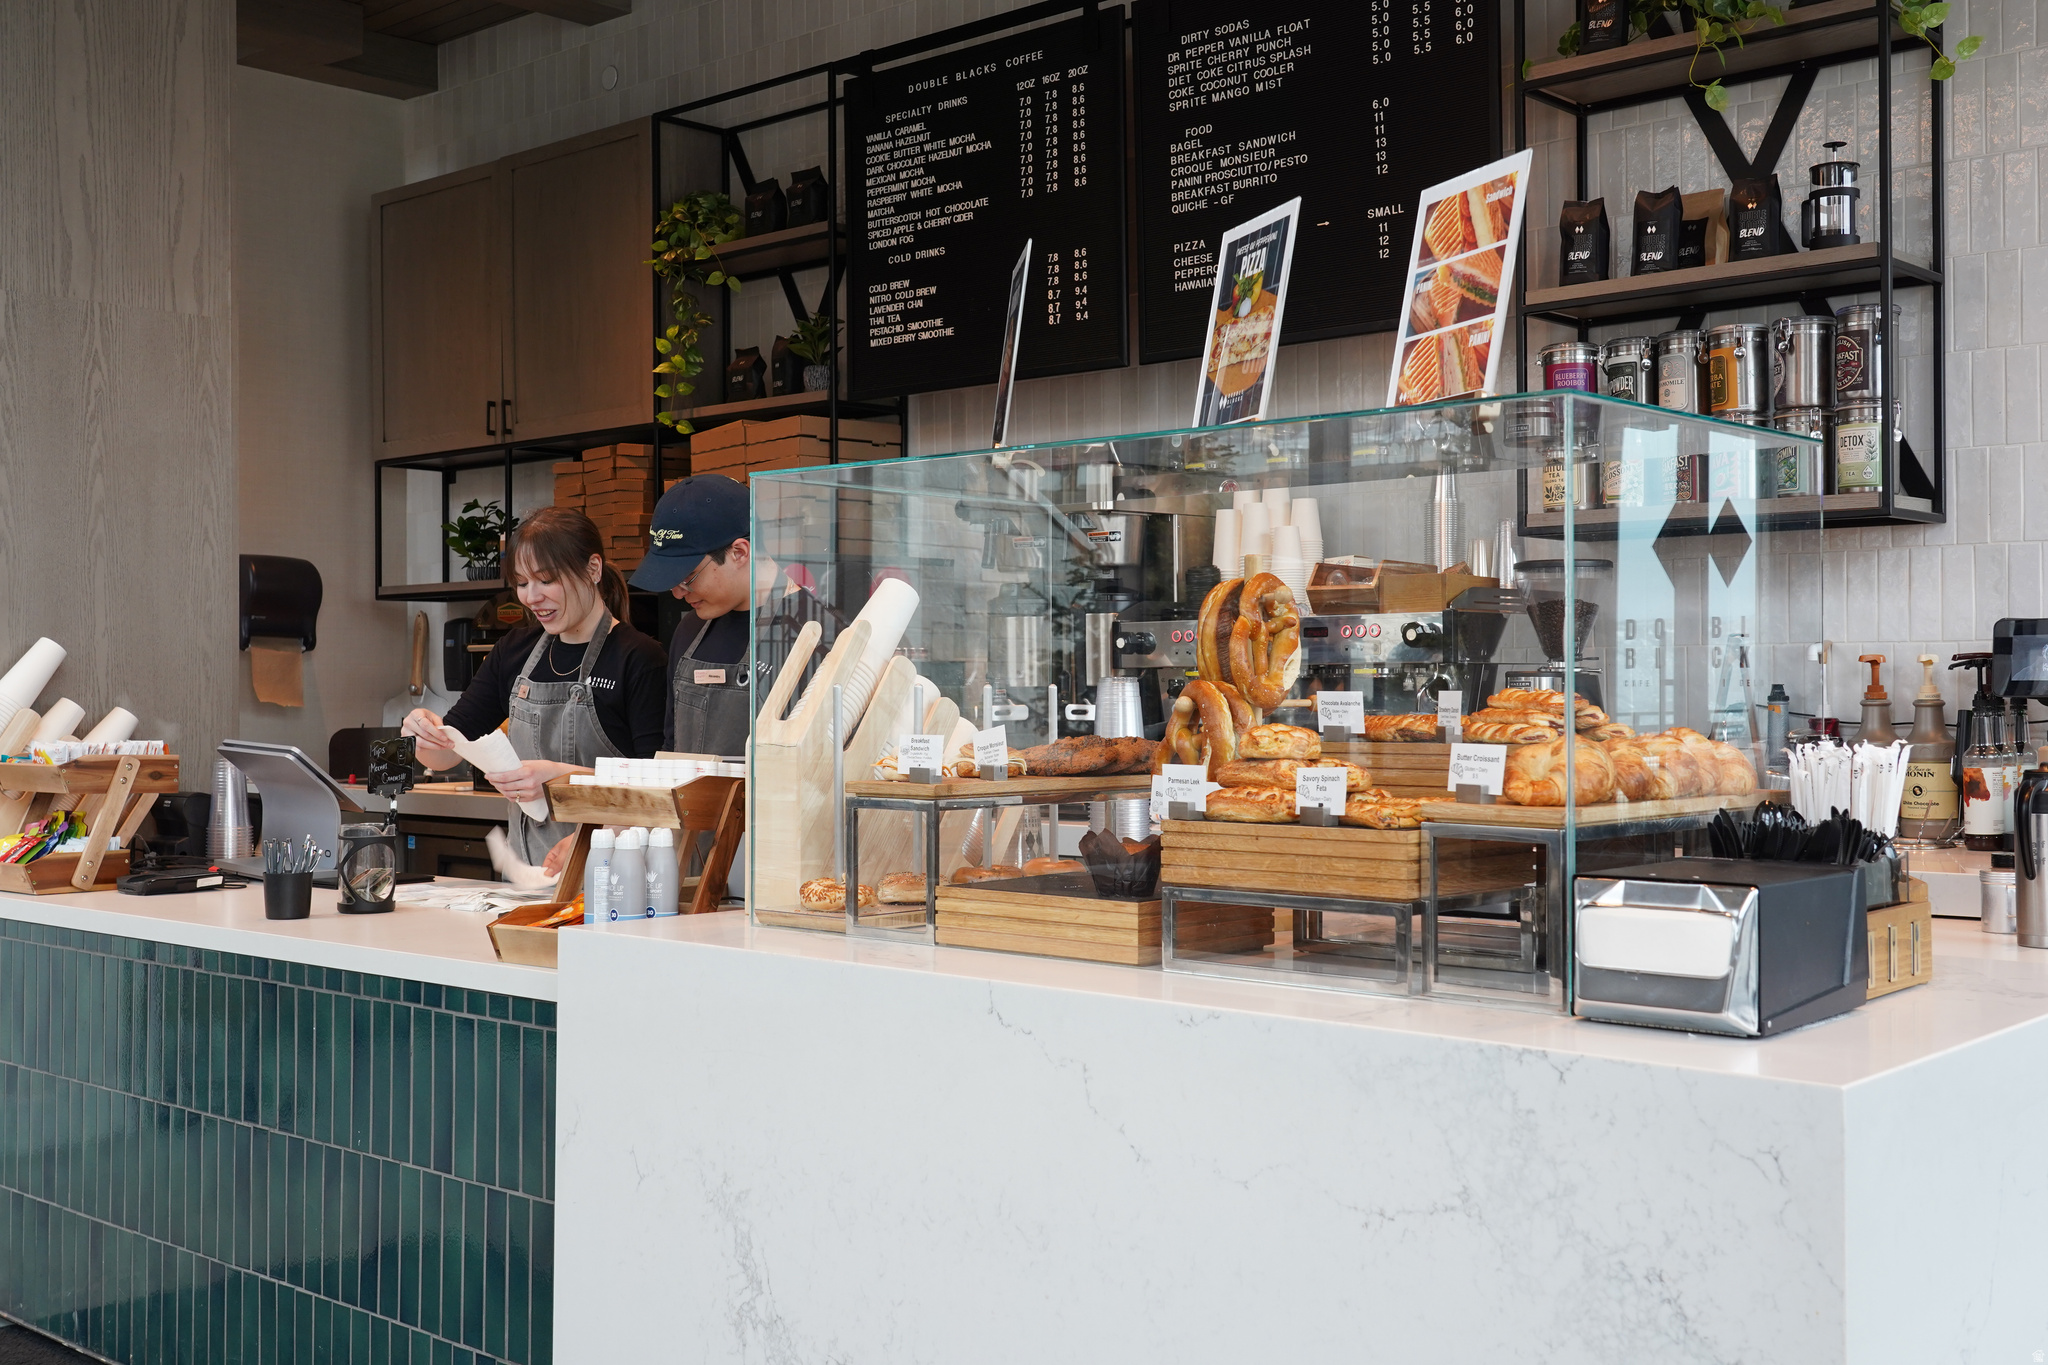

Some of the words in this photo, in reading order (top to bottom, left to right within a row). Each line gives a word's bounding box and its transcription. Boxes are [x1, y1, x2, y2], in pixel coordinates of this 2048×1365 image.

[1181, 29, 1209, 45] DIRTY
[1215, 19, 1249, 36] SODAS
[1588, 20, 1614, 30] BLEND
[1167, 59, 1202, 75] SPRITE
[1207, 47, 1249, 66] CHERRY
[1256, 36, 1291, 54] PUNCH
[1371, 12, 1389, 25] 5.0
[1412, 1, 1430, 14] 5.5
[1455, 4, 1473, 17] 6.0
[1168, 52, 1180, 63] DR
[1185, 41, 1224, 59] PEPPER
[1228, 29, 1271, 47] VANILLA
[1277, 18, 1310, 36] FLOAT
[908, 75, 948, 93] DOUBLE
[956, 63, 996, 81] BLACKS
[1005, 50, 1043, 68] COFFEE
[1168, 85, 1194, 99] COKE
[1200, 73, 1248, 92] COCONUT
[1253, 62, 1294, 80] COOLER
[1372, 39, 1390, 51] 5.0
[1413, 28, 1430, 41] 5.5
[1456, 32, 1473, 44] 6.0
[1168, 73, 1191, 88] DIET
[1197, 66, 1223, 80] COKE
[1227, 56, 1266, 73] CITRUS
[1270, 44, 1311, 63] SPLASH
[1016, 78, 1035, 91] 12OZ
[1042, 72, 1060, 84] 16OZ
[1169, 95, 1207, 112] SPRITE
[1212, 86, 1250, 102] MANGO
[1256, 77, 1283, 92] MIST
[866, 130, 892, 143] VANILLA
[895, 122, 926, 136] CARAMEL
[1019, 96, 1031, 106] 7.0
[1045, 89, 1057, 100] 7.8
[1072, 83, 1085, 93] 8.6
[885, 105, 932, 123] SPECIALTY
[938, 96, 968, 111] DRINKS
[1170, 139, 1203, 153] BAGEL
[1372, 97, 1389, 109] 6.0
[1185, 124, 1213, 138] FOOD
[865, 152, 891, 165] COOKIE
[893, 145, 921, 159] BUTTER
[923, 139, 946, 152] WHITE
[949, 133, 976, 146] MOCHA
[866, 141, 894, 154] BANANA
[895, 132, 931, 147] HAZELNUT
[1170, 144, 1231, 165] BREAKFAST
[1238, 130, 1296, 151] SANDWICH
[1374, 111, 1383, 122] 11
[866, 164, 884, 176] DARK
[886, 155, 926, 171] CHOCOLATE
[928, 146, 963, 162] HAZELNUT
[966, 140, 992, 153] MOCHA
[1170, 160, 1213, 177] CROQUE
[1220, 148, 1275, 167] MONSIEUR
[1171, 175, 1202, 189] PANINI
[1376, 137, 1387, 148] 13
[866, 173, 896, 187] MEXICAN
[899, 167, 924, 179] MOCHA
[867, 181, 909, 197] PEPPERMINT
[911, 175, 936, 188] MOCHA
[1171, 182, 1230, 202] BREAKFAST
[1233, 173, 1277, 190] BURRITO
[867, 192, 907, 208] RASPBERRY
[910, 187, 933, 199] WHITE
[937, 181, 963, 193] MOCHA
[1171, 199, 1208, 214] QUICHE
[1376, 164, 1388, 175] 12
[867, 211, 921, 229] BUTTERSCOTCH
[926, 207, 941, 218] HOT
[944, 197, 989, 214] CHOCOLATE
[1021, 188, 1033, 198] 7.0
[1046, 183, 1058, 193] 7.8
[1074, 176, 1087, 187] 8.6
[867, 206, 895, 218] MATCHA
[867, 228, 892, 240] SPICED
[892, 223, 915, 235] APPLE
[917, 222, 922, 230] &
[923, 216, 952, 229] CHERRY
[953, 212, 973, 223] CIDER
[1174, 239, 1206, 253] PIZZA
[1367, 204, 1404, 219] SMALL
[1739, 227, 1764, 239] BLEND
[869, 237, 897, 250] LONDON
[899, 234, 914, 245] FOG
[1173, 253, 1213, 268] CHEESE
[1379, 222, 1388, 233] 11
[1379, 235, 1389, 246] 12
[888, 253, 911, 264] COLD
[915, 247, 945, 259] DRINKS
[1239, 247, 1267, 281] PIZZA
[1568, 251, 1590, 261] BLEND
[1640, 252, 1664, 262] BLEND
[869, 283, 888, 294] COLD
[890, 279, 910, 290] BREW
[1048, 253, 1059, 263] 7.8
[1074, 248, 1087, 258] 8.6
[869, 293, 892, 304] NITRO
[895, 290, 914, 300] COLD
[916, 286, 937, 297] BREW
[869, 316, 884, 326] THAI
[887, 314, 901, 323] TEA
[1048, 290, 1061, 300] 8.7
[1075, 285, 1087, 295] 9.4
[869, 302, 905, 315] LAVENDER
[907, 299, 923, 309] CHAI
[870, 324, 904, 337] PISTACHIO
[907, 318, 943, 331] SMOOTHIE
[870, 336, 892, 347] MIXED
[893, 333, 916, 344] BERRY
[918, 327, 954, 340] SMOOTHIE
[1555, 372, 1588, 381] BLUEBERRY
[1557, 380, 1586, 388] ROOIBOS
[1659, 378, 1686, 388] AMOMILE
[1840, 434, 1865, 448] DETOX
[1320, 699, 1340, 707] Chocolate
[1340, 699, 1361, 707] Avalanche
[910, 737, 930, 745] Breakfast
[910, 745, 930, 753] Sandwich
[1456, 753, 1473, 762] Butter
[1473, 754, 1500, 764] Croissant
[1167, 776, 1190, 785] Parmesan
[1189, 777, 1201, 786] Leek
[1302, 775, 1321, 784] Savory
[1321, 775, 1341, 784] Spinach
